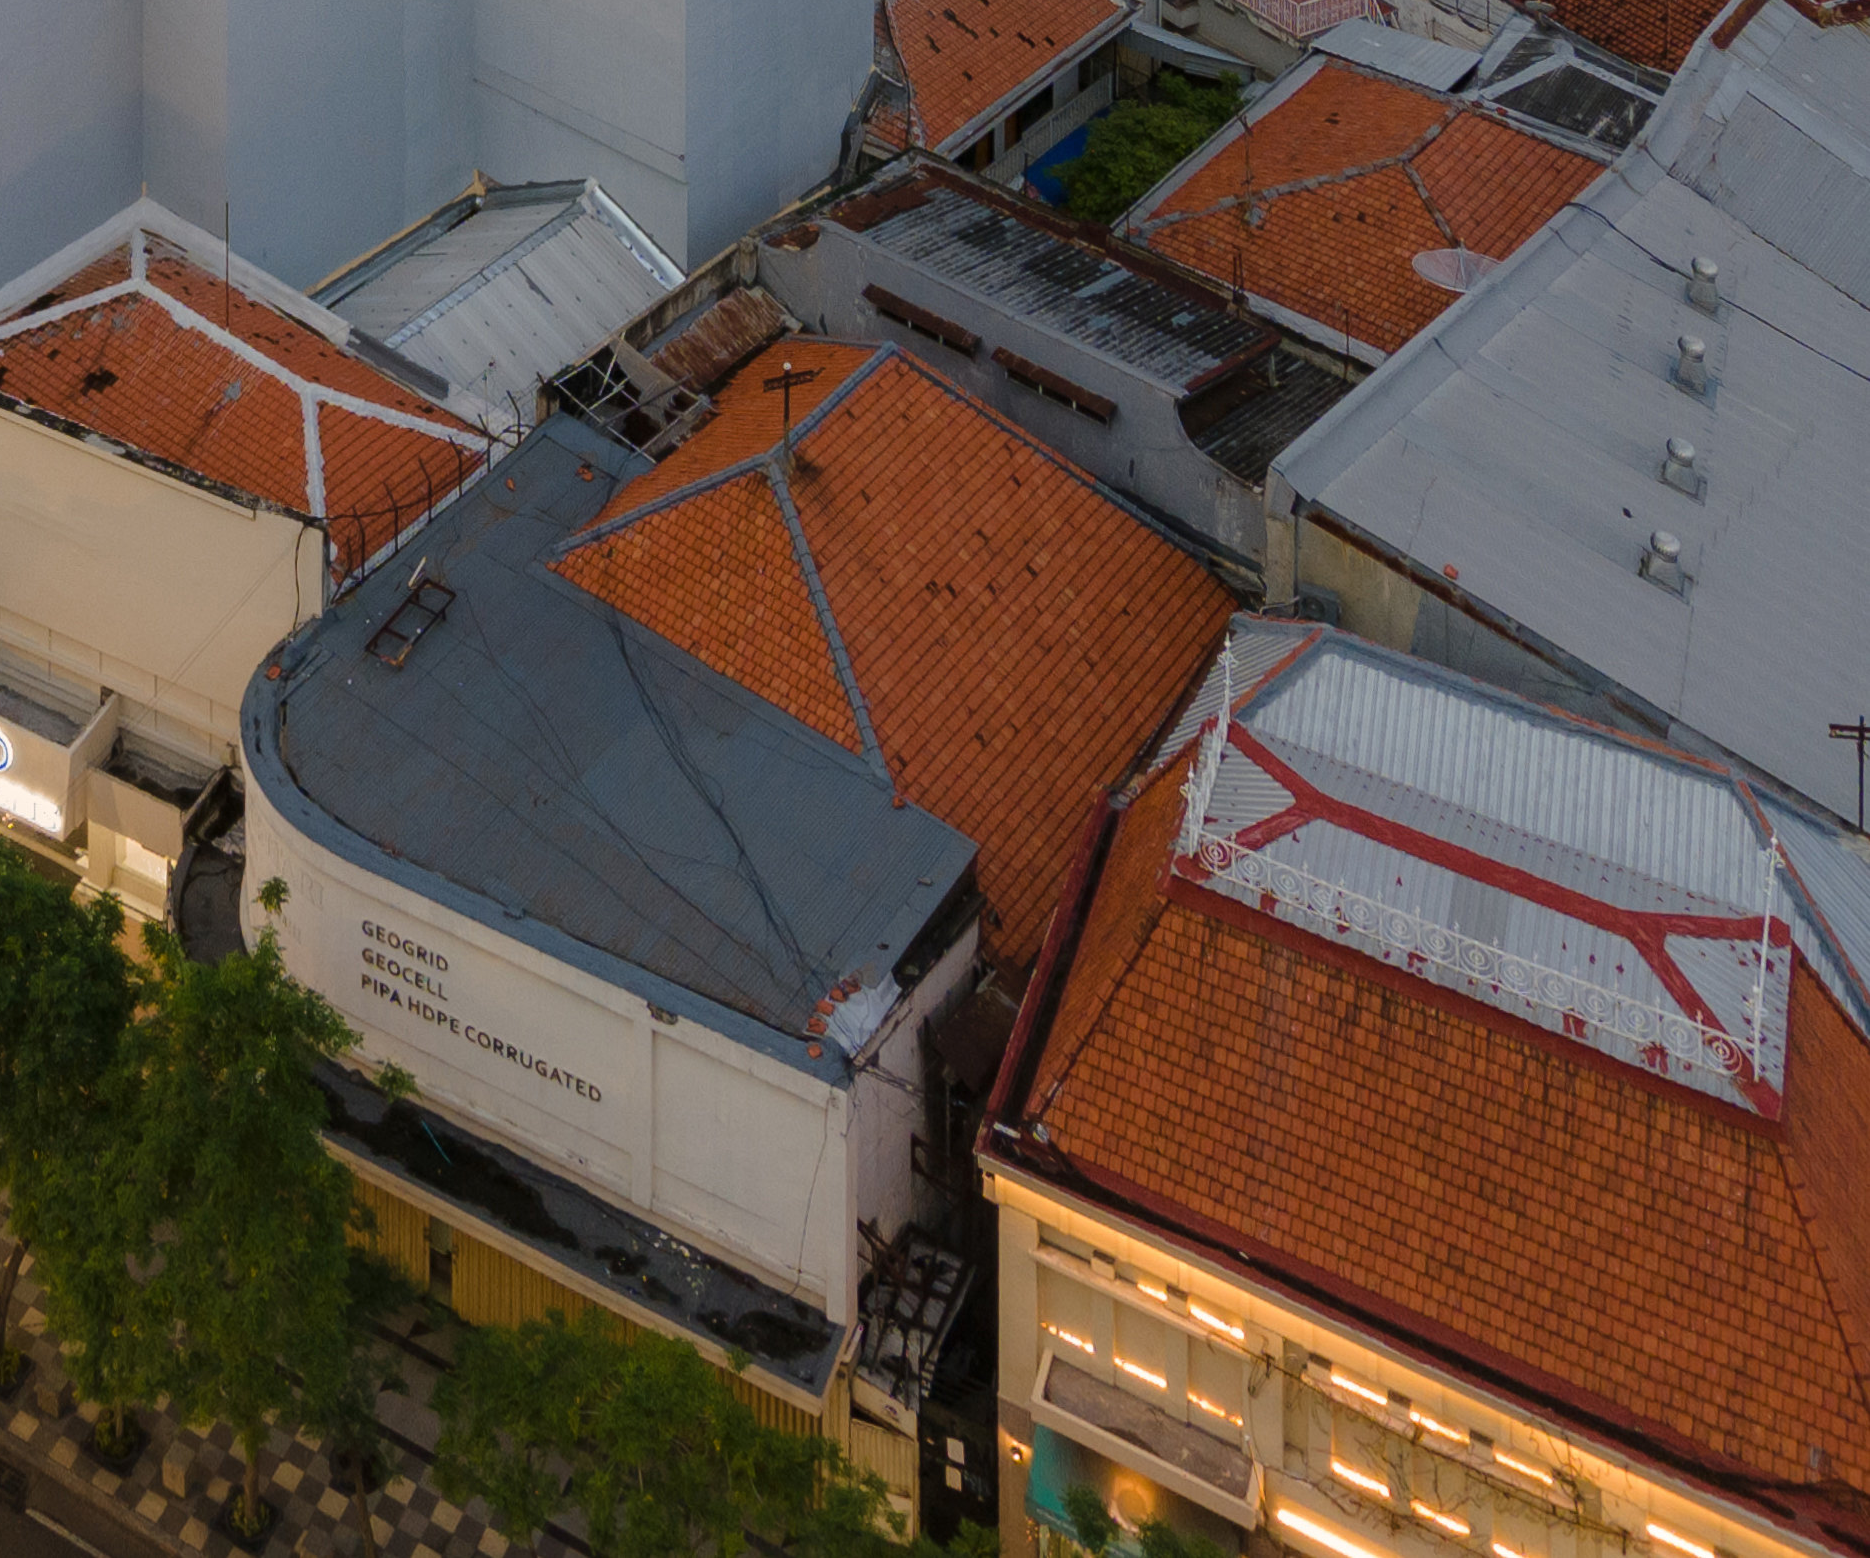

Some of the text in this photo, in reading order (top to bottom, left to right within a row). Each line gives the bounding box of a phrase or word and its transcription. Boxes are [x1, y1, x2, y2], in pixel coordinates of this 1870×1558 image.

[361, 920, 449, 972] GEOGRID
[361, 948, 448, 1001] GEOCELL
[361, 974, 602, 1102] PIPA HDPE CORRUGATED
